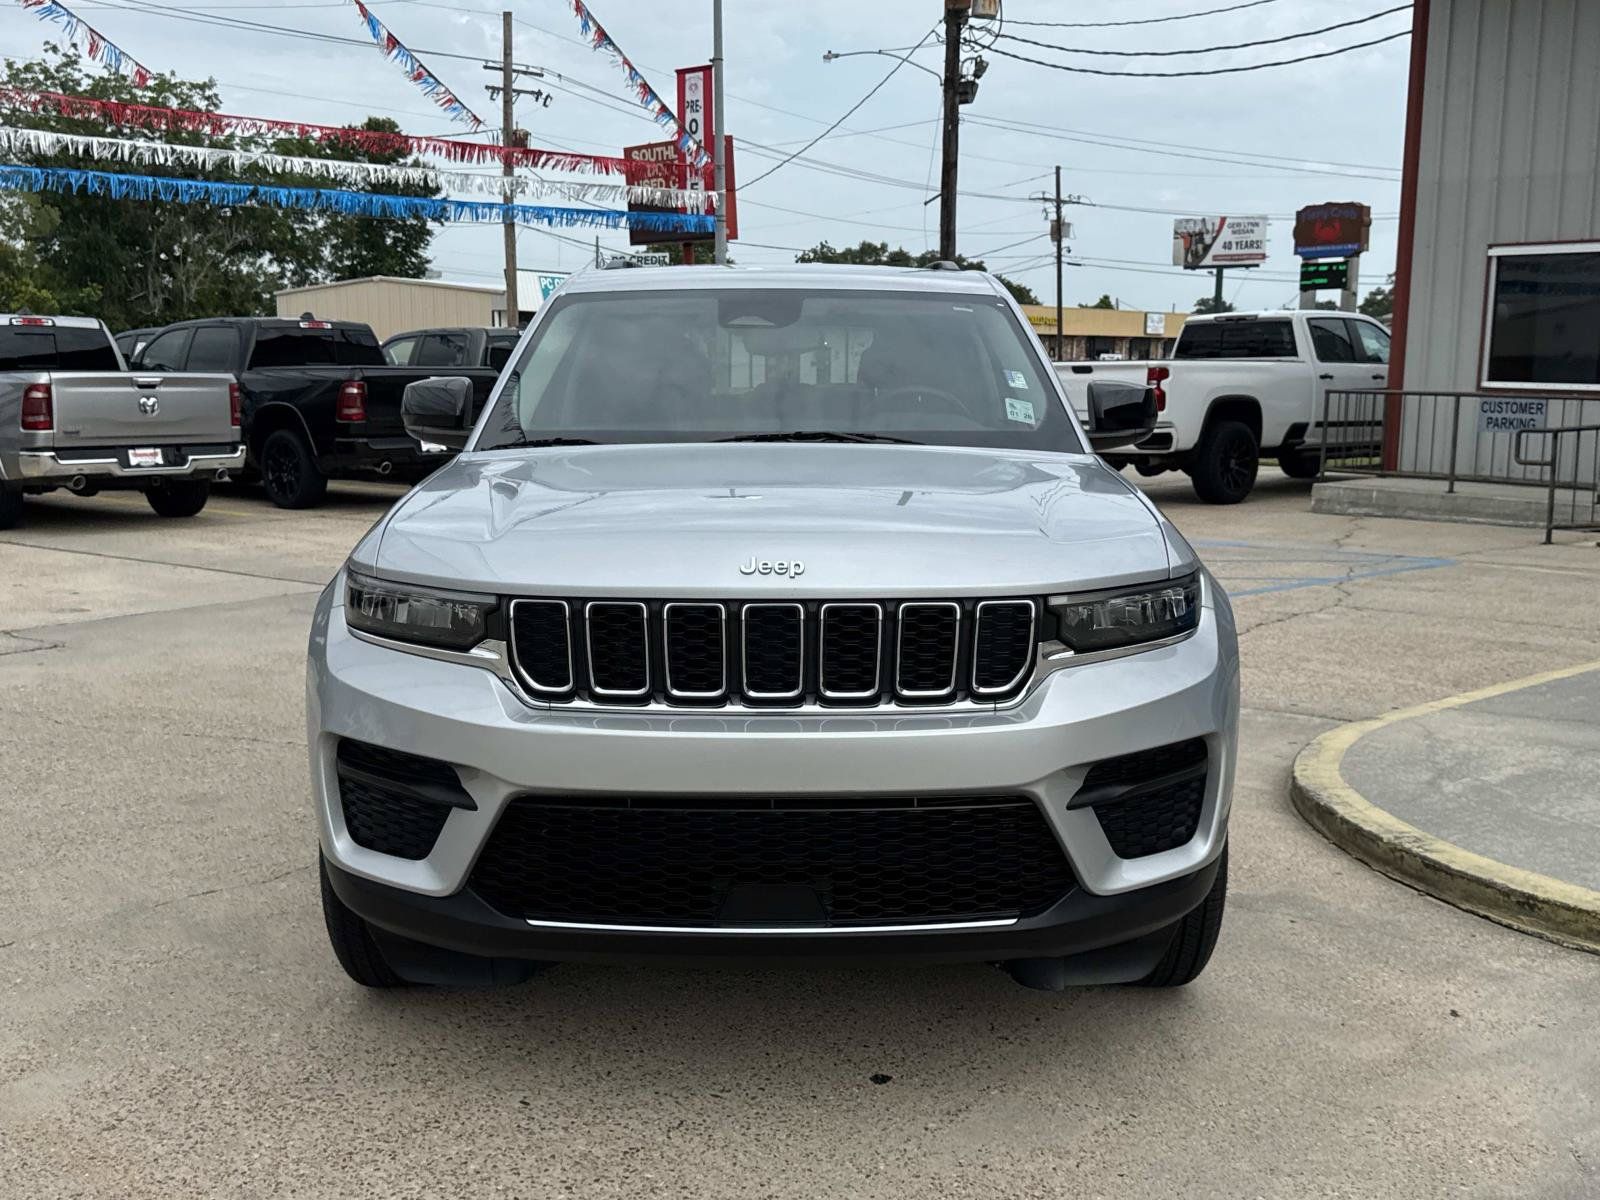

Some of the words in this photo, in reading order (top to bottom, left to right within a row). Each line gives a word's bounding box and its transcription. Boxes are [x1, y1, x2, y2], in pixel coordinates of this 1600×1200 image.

[1222, 240, 1233, 250] 40
[1235, 239, 1263, 250] YEARS!
[1481, 400, 1544, 415] CUSTOMER
[1486, 417, 1536, 429] PARKING
[740, 556, 805, 579] Jeep
